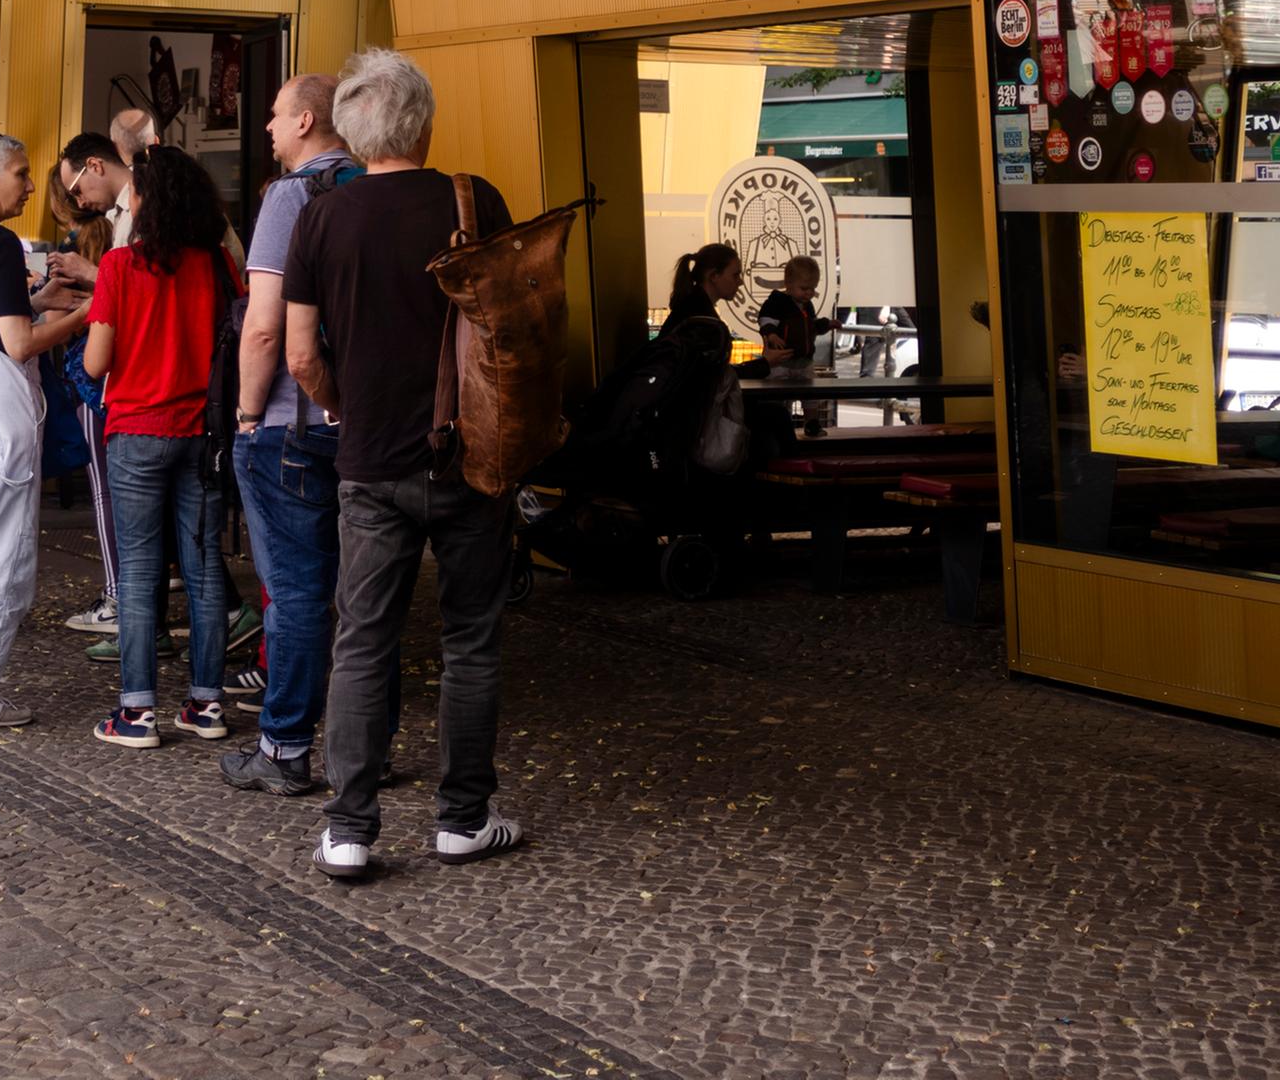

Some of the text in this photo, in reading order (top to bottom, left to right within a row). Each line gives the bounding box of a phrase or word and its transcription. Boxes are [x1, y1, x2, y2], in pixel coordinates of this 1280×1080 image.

[1001, 8, 1020, 21] ECHT
[1044, 43, 1063, 54] 2014
[997, 85, 1017, 96] 420
[998, 96, 1017, 107] 247
[1094, 293, 1161, 328] SAMSTAGS
[1129, 392, 1177, 422] MONTAGS
[1100, 415, 1193, 442] GESCHLOSSEN
